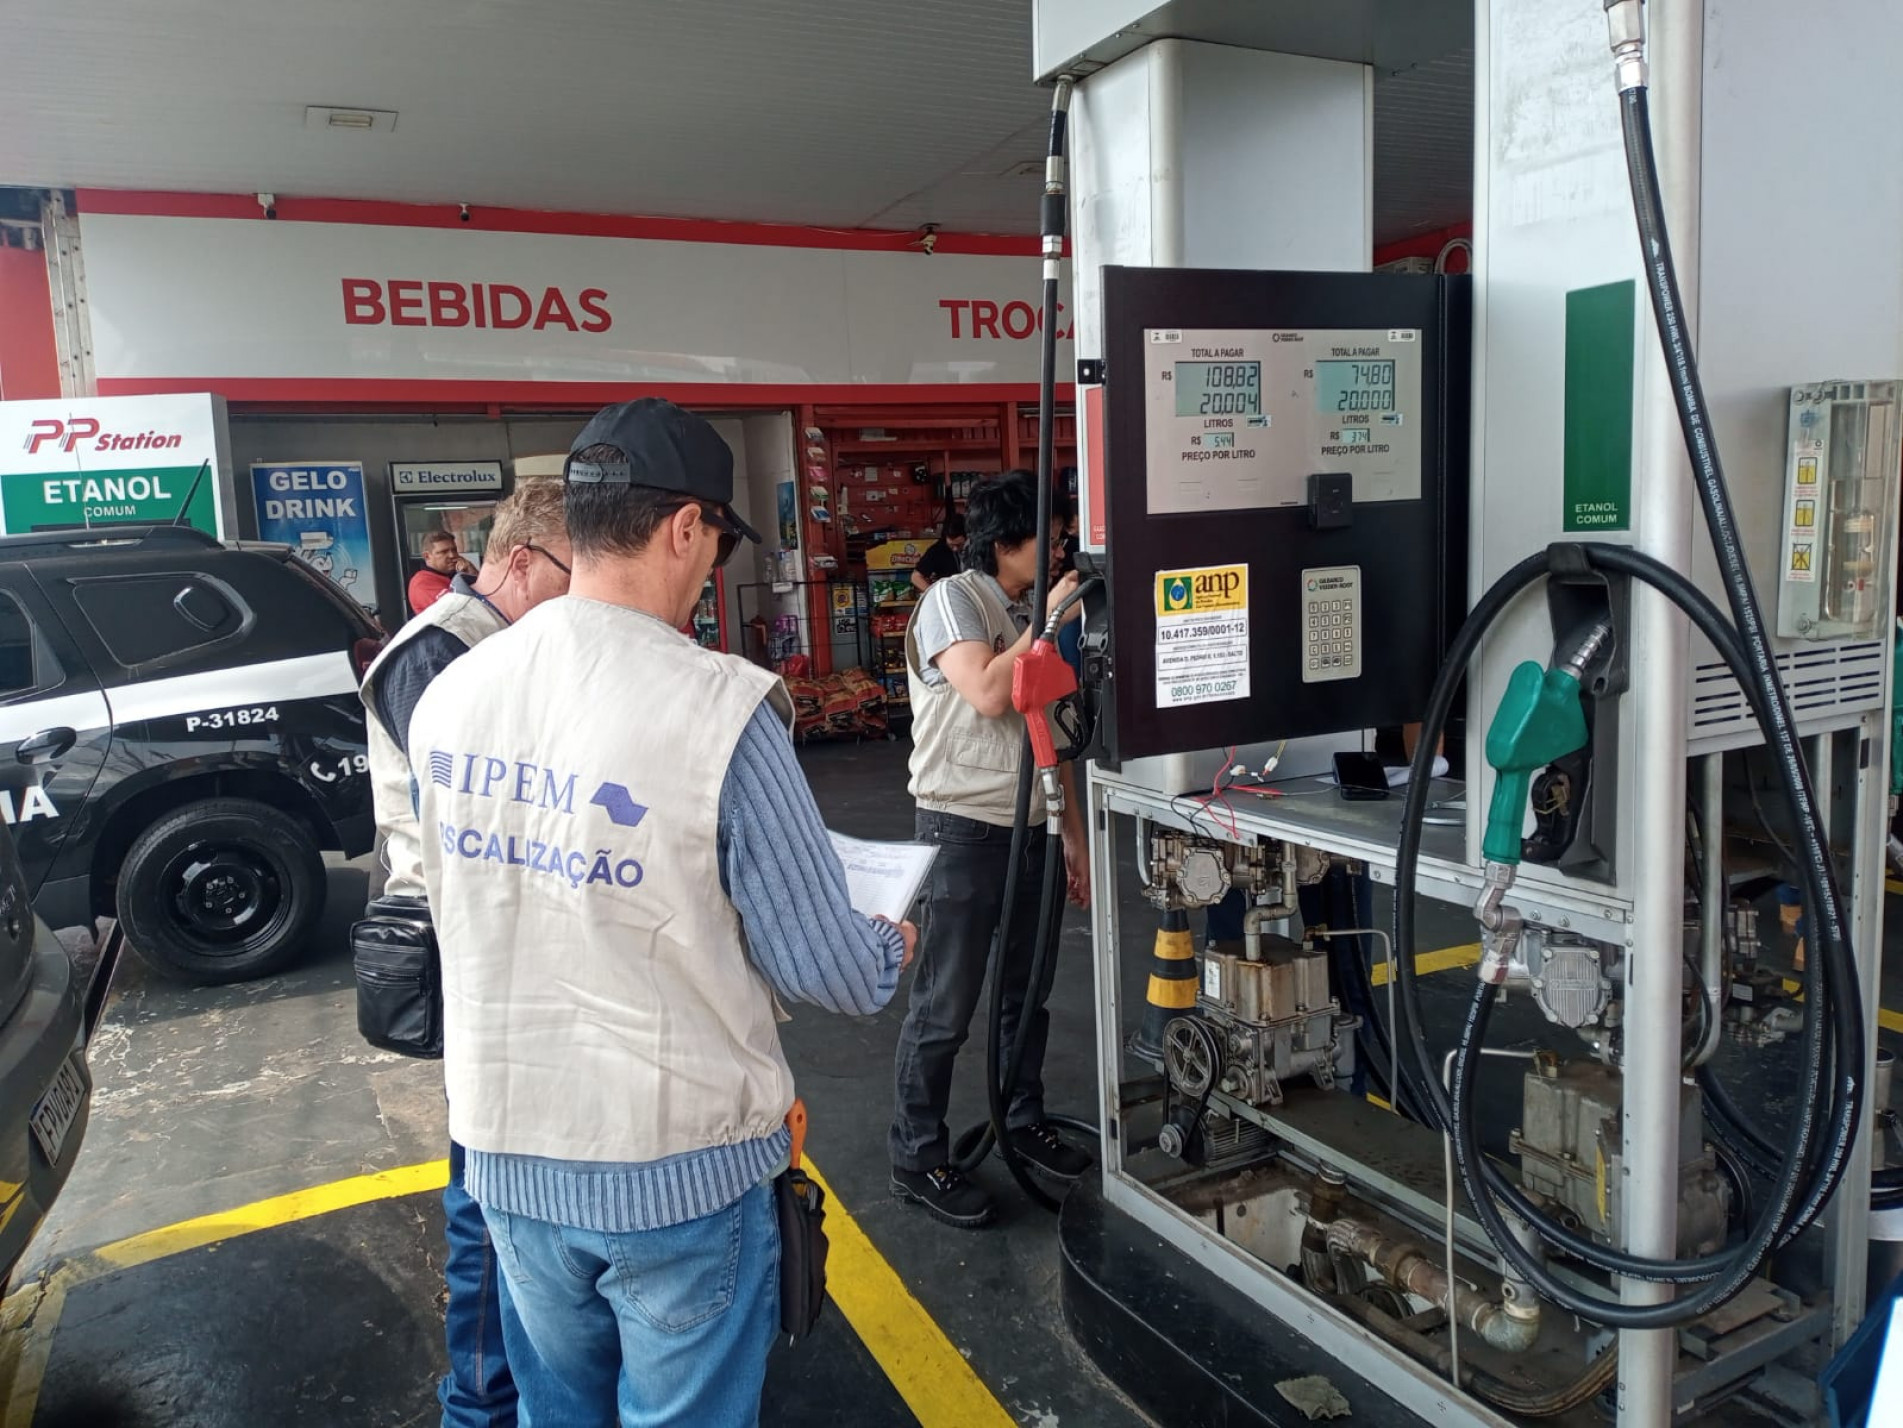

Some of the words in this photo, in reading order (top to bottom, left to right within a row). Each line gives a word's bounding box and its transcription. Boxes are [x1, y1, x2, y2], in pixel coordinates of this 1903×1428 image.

[341, 278, 612, 333] BEBIDAS
[939, 299, 1074, 339] TROC
[1191, 348, 1213, 358] TOTAL
[1214, 349, 1219, 357] A
[1220, 348, 1244, 357] PAGAR
[1331, 347, 1352, 356] TOTAL
[1358, 347, 1380, 356] PAGAR
[1161, 371, 1172, 381] R$
[1206, 365, 1258, 389] 108,82
[1303, 369, 1313, 379] R$
[1200, 393, 1258, 415] 20,004
[1682, 384, 1697, 412] BOMBA
[1203, 419, 1233, 428] LITROS
[1342, 415, 1369, 424] LITROS
[1689, 412, 1701, 426] DE
[25, 417, 100, 454] PP
[95, 431, 182, 451] Station
[1191, 436, 1201, 445] R$
[1330, 431, 1340, 440] R$
[1182, 451, 1211, 462] PREÇO
[1212, 450, 1230, 460] POR
[1232, 449, 1256, 459] LITRO
[1321, 446, 1348, 456] PREÇO
[1350, 445, 1366, 454] POR
[1367, 445, 1390, 453] LITRO
[269, 471, 347, 491] GELO
[417, 470, 496, 484] Electrolux
[43, 476, 172, 504] ETANOL
[83, 505, 136, 517] COMUM
[265, 498, 356, 520] DRINK
[1575, 502, 1619, 513] ETANOL
[1576, 514, 1617, 525] COMUM
[1195, 571, 1240, 599] anp
[1171, 685, 1194, 697] 0800
[1195, 682, 1213, 695] 970
[1214, 680, 1238, 692] 0267
[186, 706, 280, 732] P-31824
[458, 753, 579, 814] IPEM
